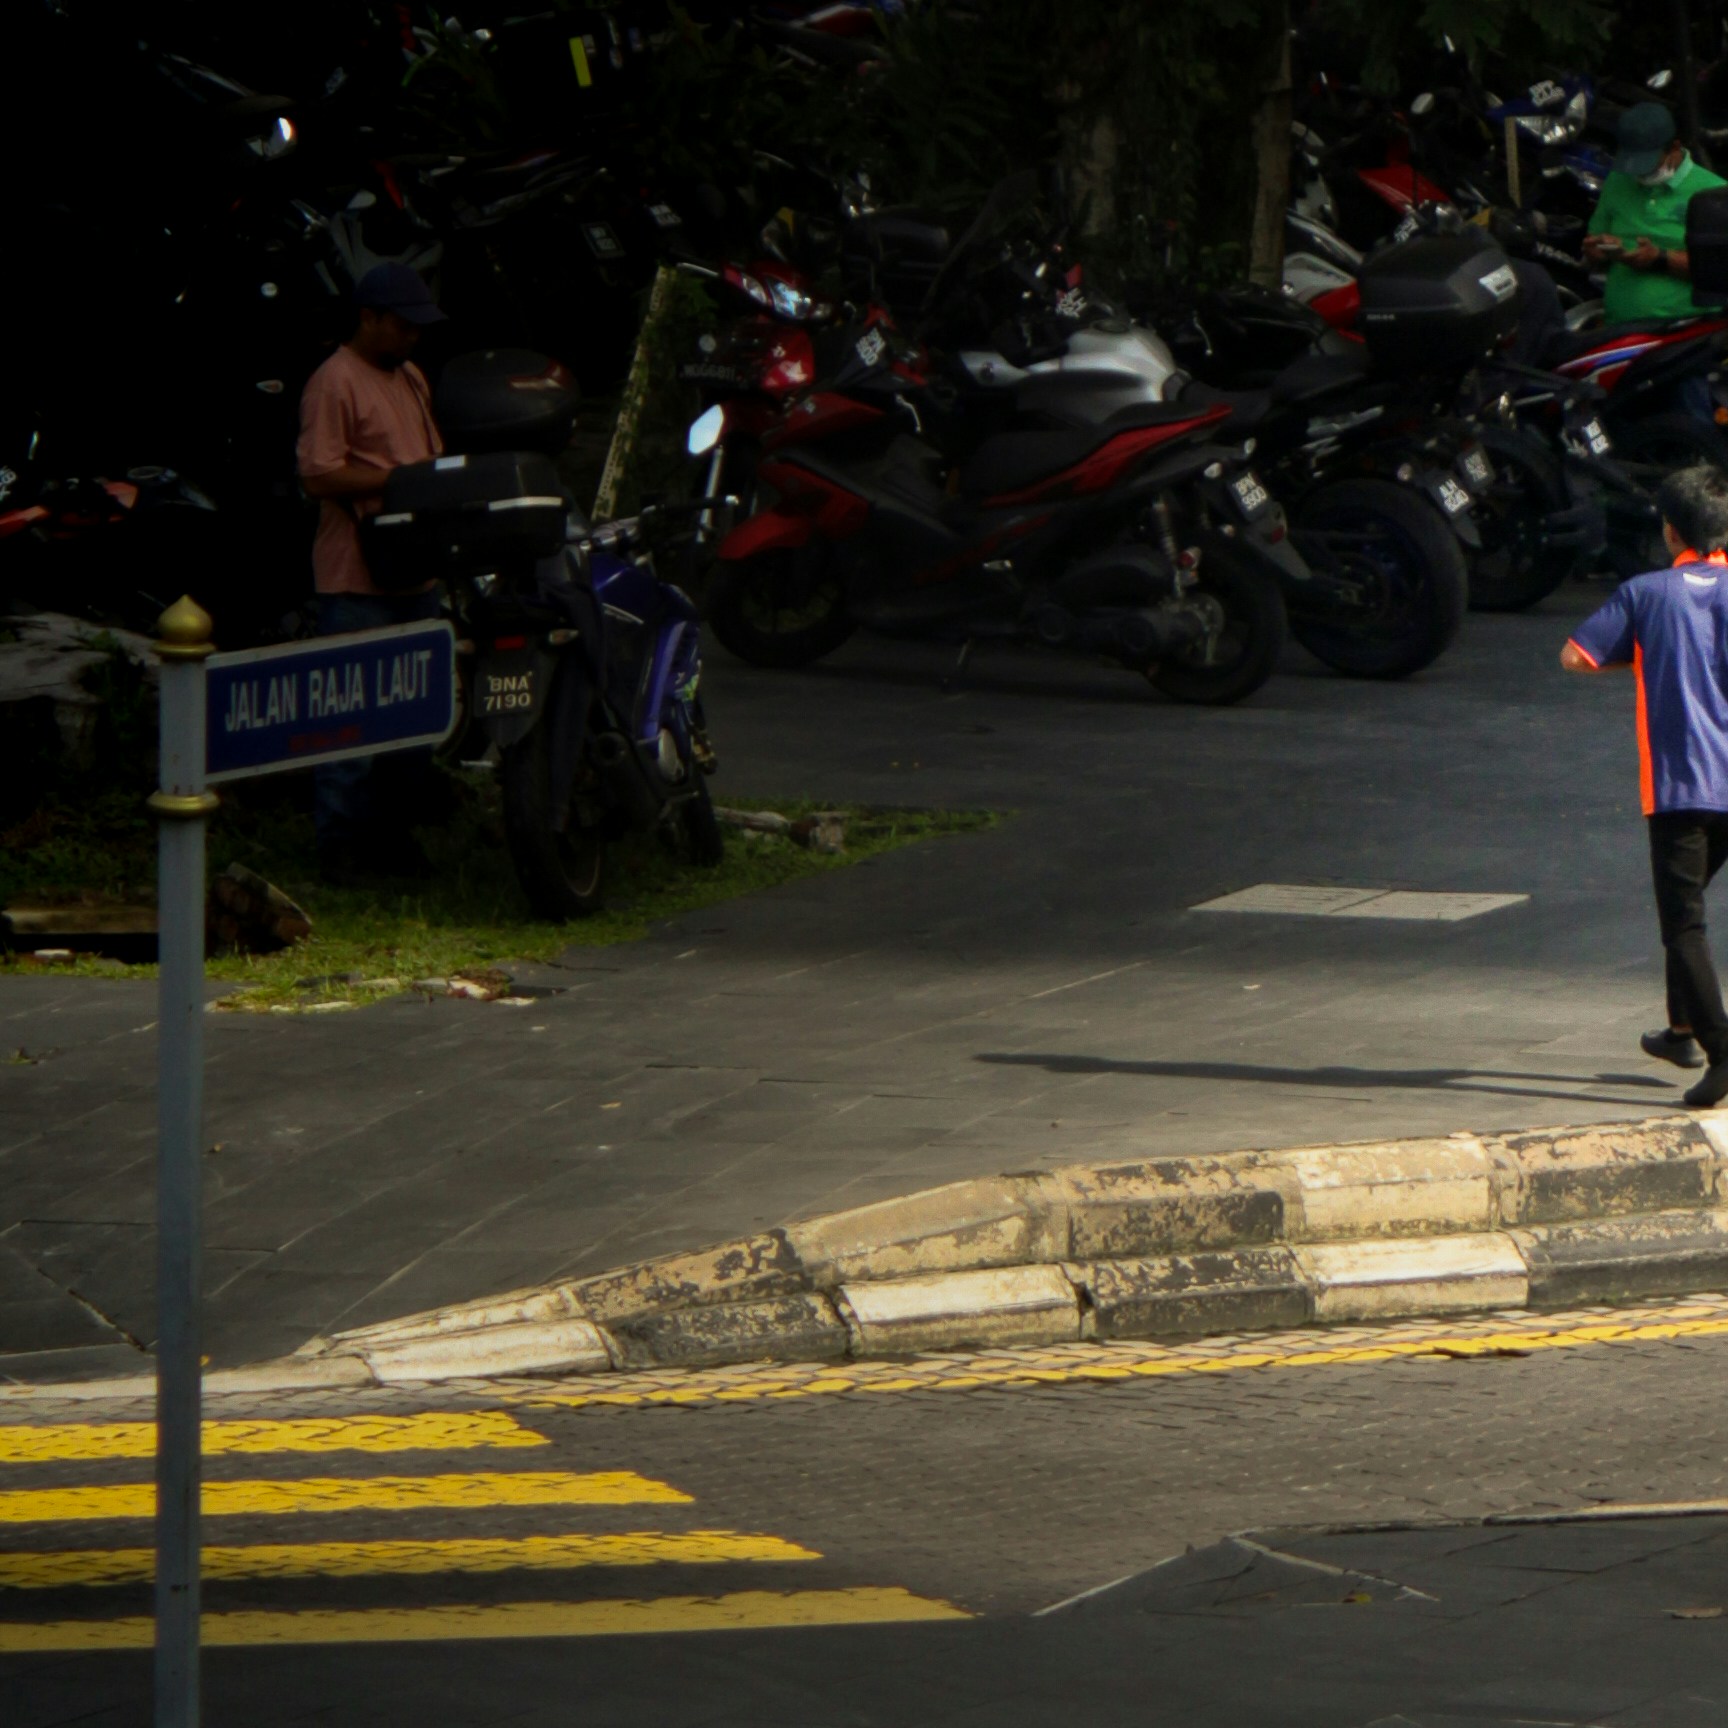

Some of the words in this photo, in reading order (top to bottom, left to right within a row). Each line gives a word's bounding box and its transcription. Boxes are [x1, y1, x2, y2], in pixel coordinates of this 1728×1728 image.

[225, 673, 297, 732] JALAN
[308, 662, 365, 719] RAJA
[376, 649, 432, 708] LAUT
[489, 674, 530, 693] BNA
[483, 692, 532, 712] 7190
